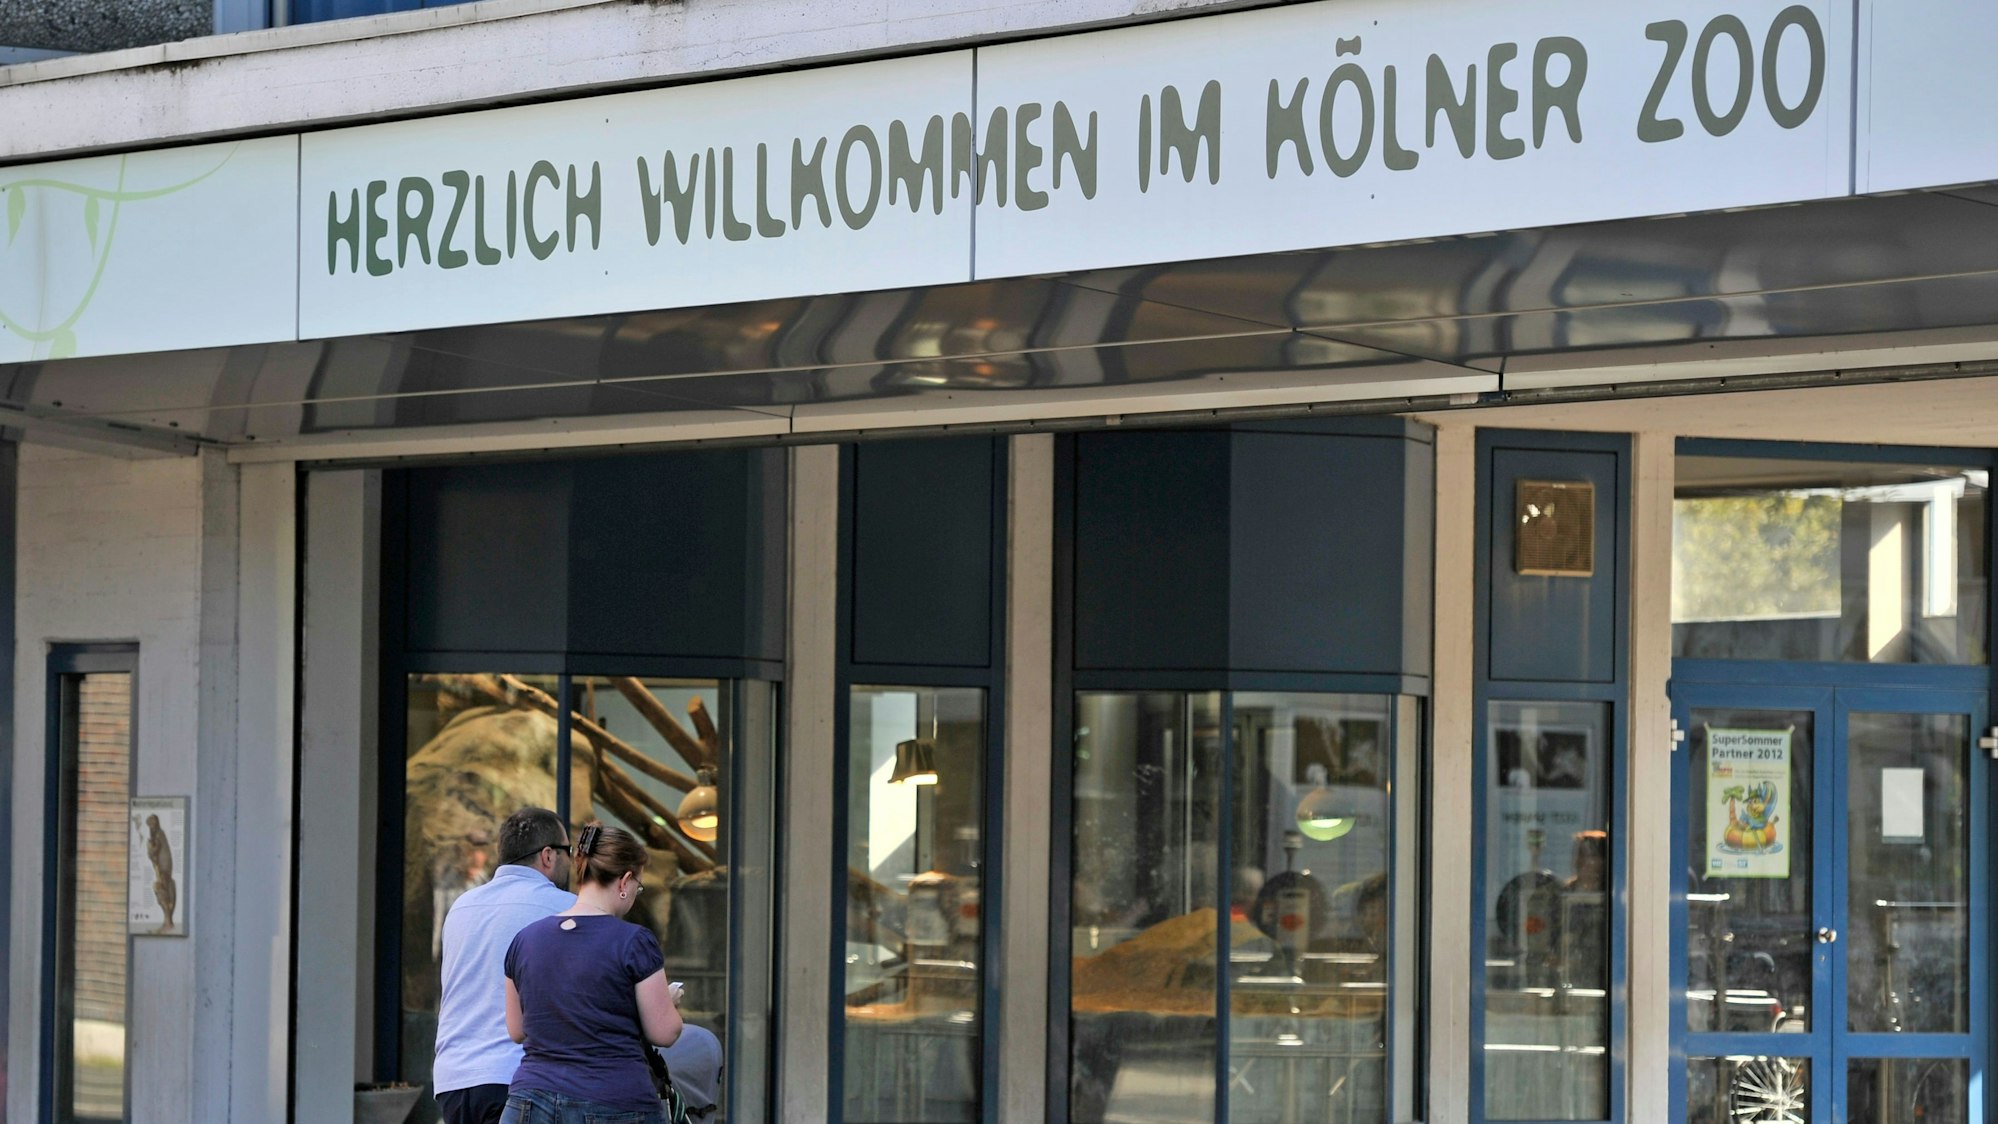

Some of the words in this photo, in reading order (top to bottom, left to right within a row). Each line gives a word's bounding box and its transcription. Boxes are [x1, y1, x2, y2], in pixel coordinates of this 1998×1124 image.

[327, 158, 603, 277] HERZLICH
[637, 100, 1098, 248] WILLKOMMEN
[1138, 79, 1222, 195] IM
[1265, 35, 1589, 180] KÖLNER
[1636, 4, 1827, 144] ZOO
[1712, 734, 1783, 746] SuperSommer
[1712, 747, 1754, 759] Partner
[1757, 748, 1784, 760] 2012
